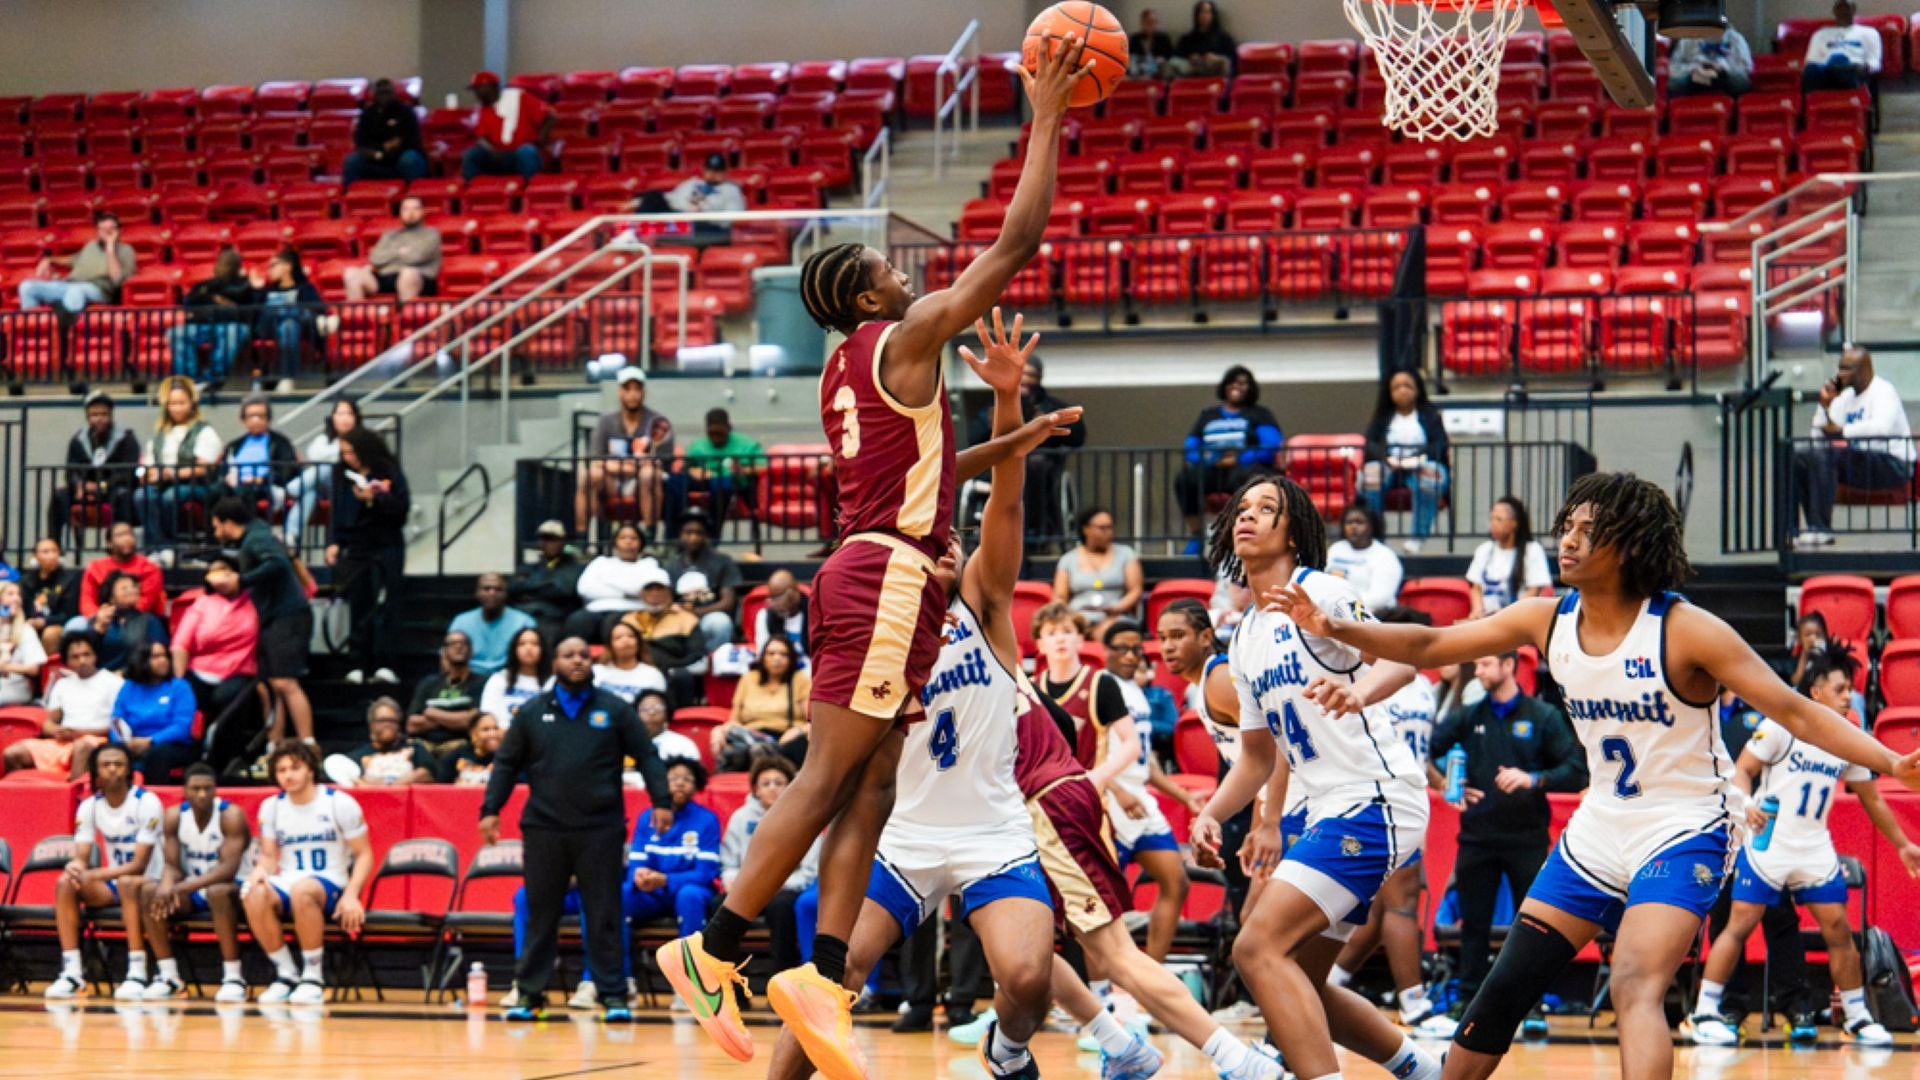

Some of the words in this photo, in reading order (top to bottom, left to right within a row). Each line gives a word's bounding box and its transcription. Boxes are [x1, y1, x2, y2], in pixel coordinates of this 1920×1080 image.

[833, 385, 860, 459] 3
[1624, 656, 1656, 678] UIL
[928, 706, 960, 771] 4
[1600, 735, 1642, 799] 2
[1797, 782, 1829, 820] 11
[294, 848, 327, 872] 10
